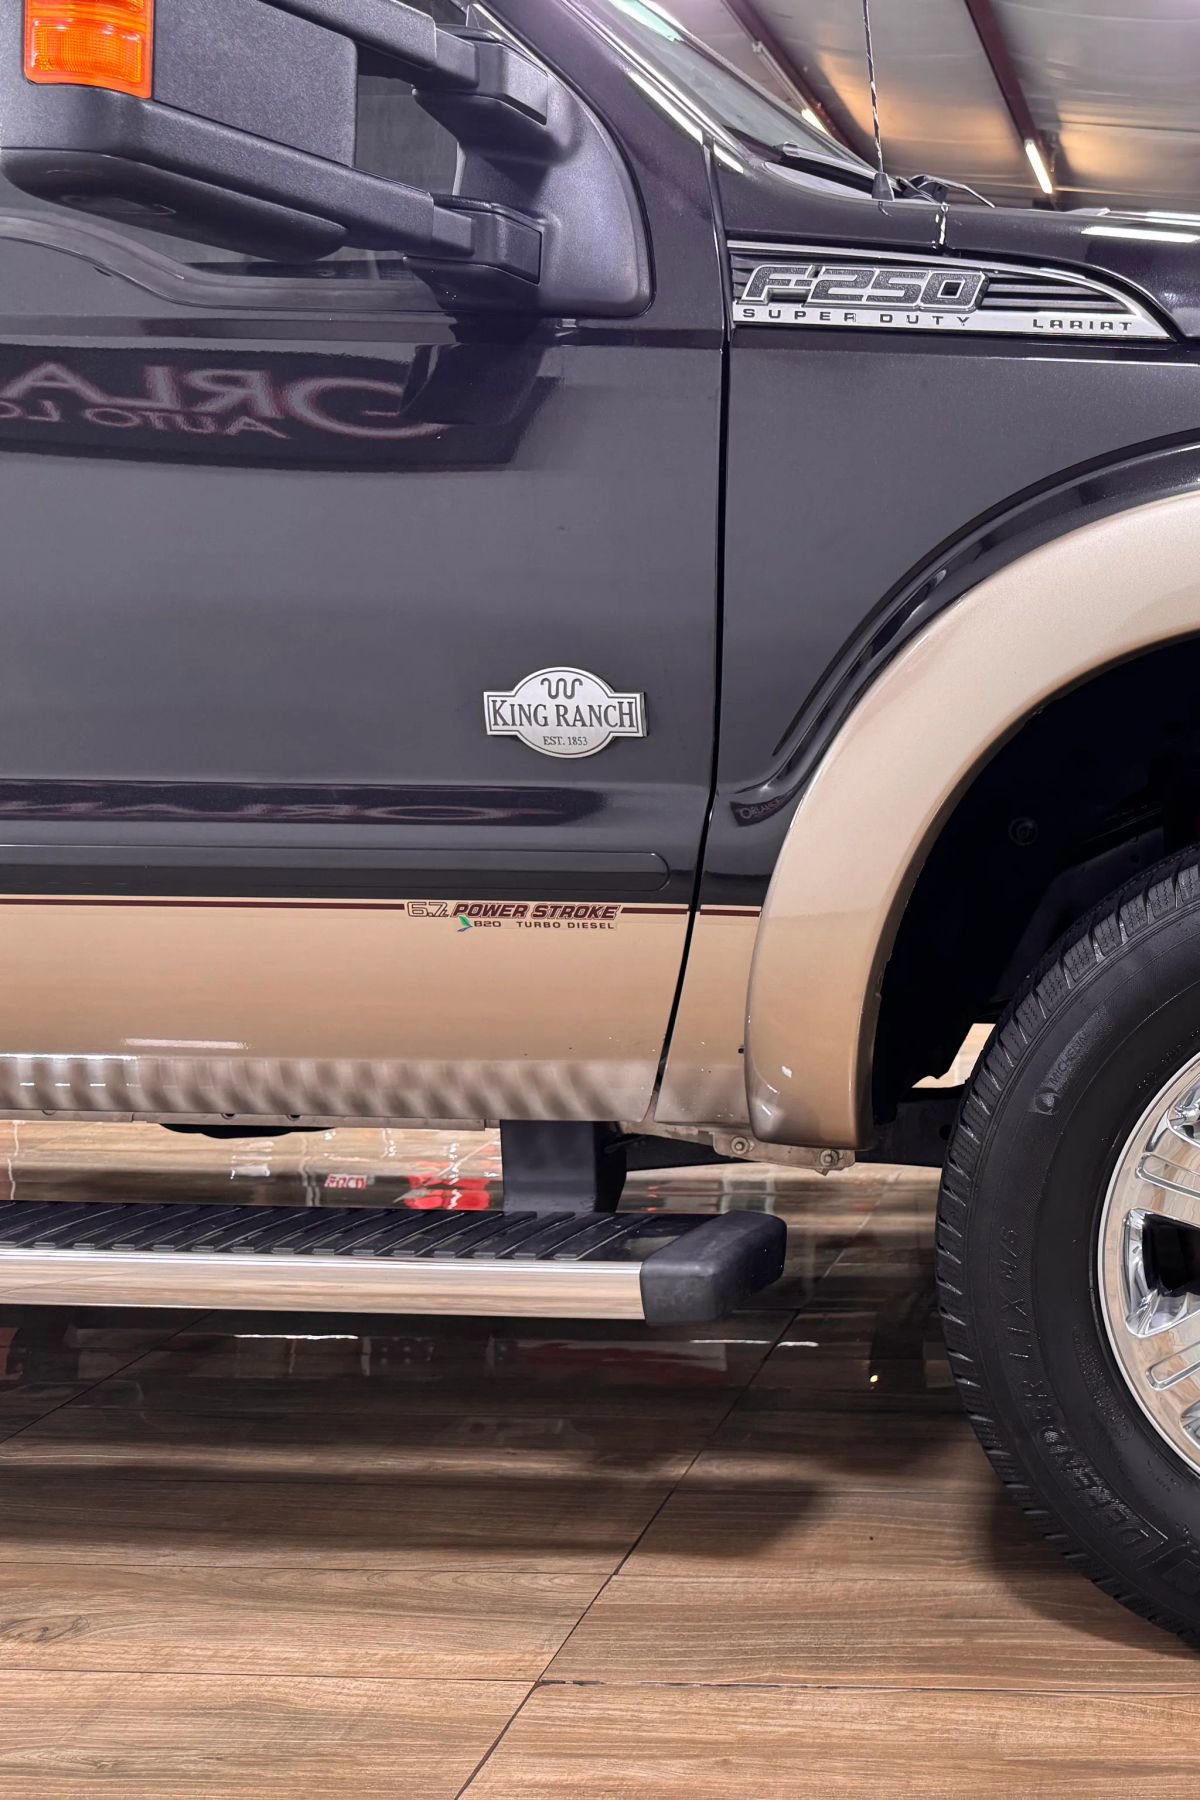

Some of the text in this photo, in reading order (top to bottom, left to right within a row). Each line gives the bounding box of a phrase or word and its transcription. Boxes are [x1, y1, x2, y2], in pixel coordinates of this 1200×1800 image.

[742, 308, 971, 328] SUPER DUTY
[1032, 318, 1133, 333] LARIAT
[491, 699, 636, 729] KING RANCH
[543, 736, 588, 747] EST. 1853
[450, 903, 530, 920] POWER
[531, 904, 622, 921] STROKE
[473, 920, 502, 928] B20
[515, 921, 615, 930] TURBO DIESEL
